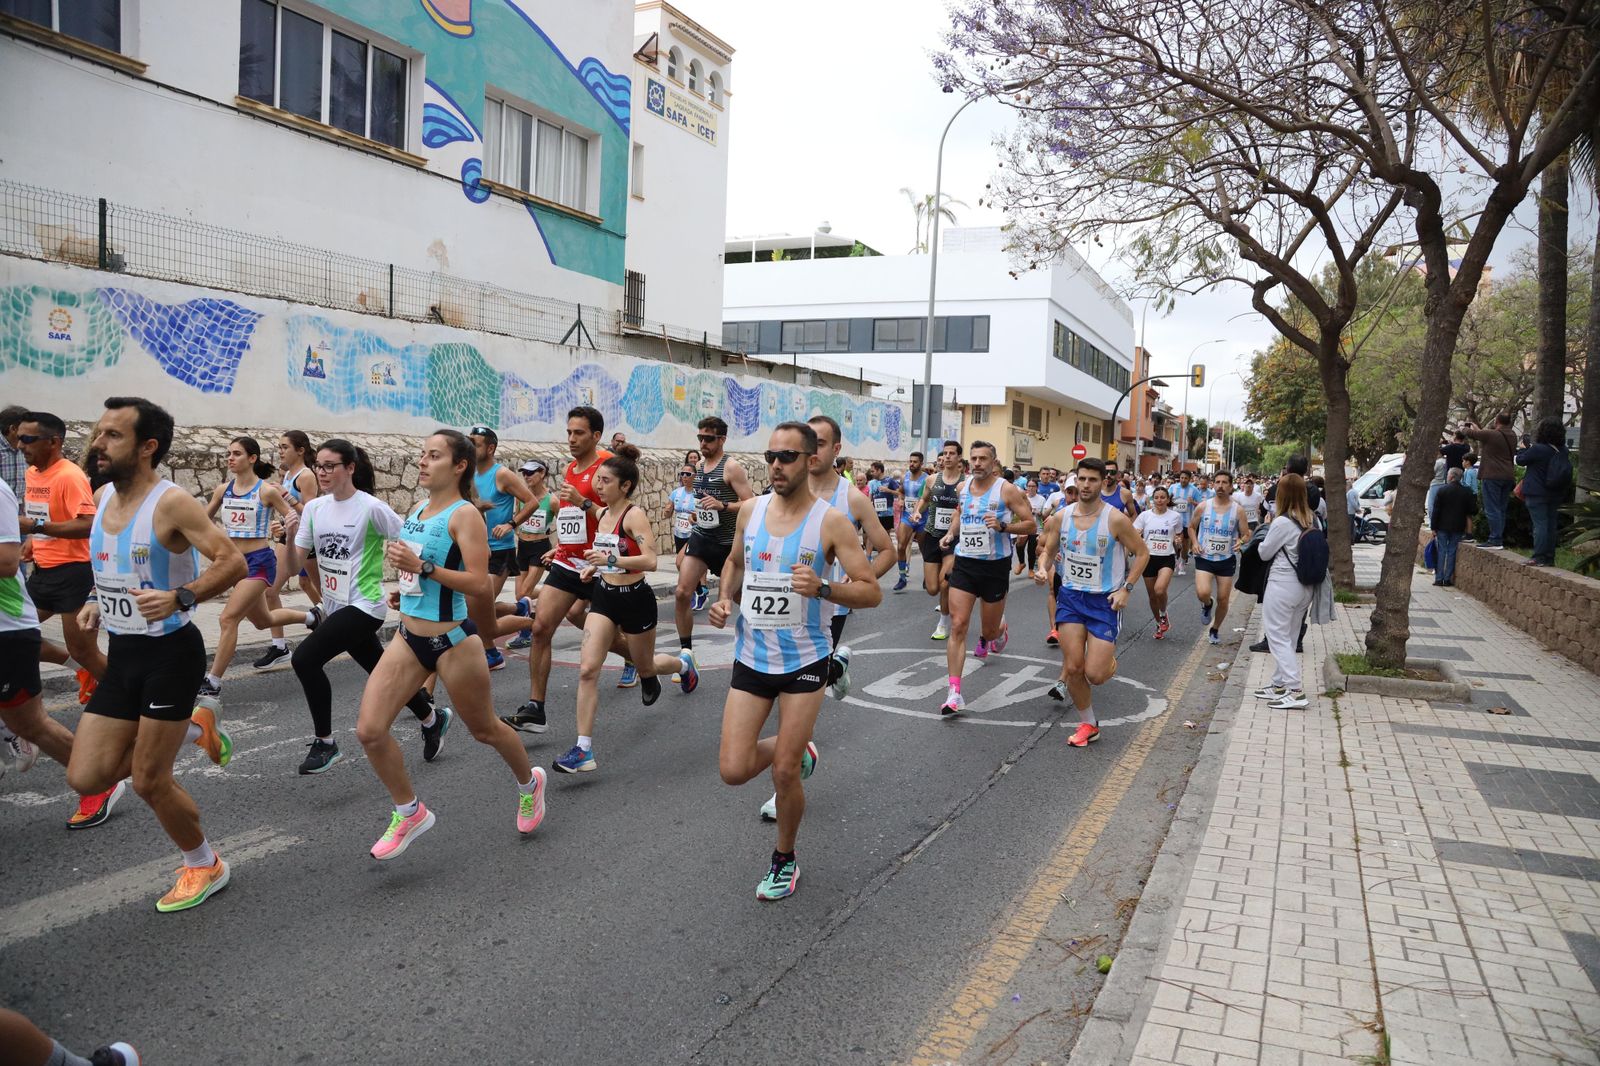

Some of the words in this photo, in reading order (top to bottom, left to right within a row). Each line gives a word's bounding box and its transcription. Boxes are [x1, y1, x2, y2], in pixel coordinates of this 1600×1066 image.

[666, 107, 688, 128] SAFA
[697, 123, 715, 141] ICET
[48, 332, 72, 341] SAFA
[231, 512, 246, 523] 24
[525, 518, 541, 527] 365
[699, 511, 714, 522] 483
[940, 516, 952, 525] 48
[403, 519, 425, 534] erja
[561, 522, 580, 535] 500
[964, 537, 983, 547] 545
[1152, 542, 1168, 550] 366
[1070, 565, 1092, 579] 525
[325, 575, 337, 591] 30
[101, 594, 132, 617] 570
[751, 596, 790, 615] 422
[862, 655, 1056, 713] 40
